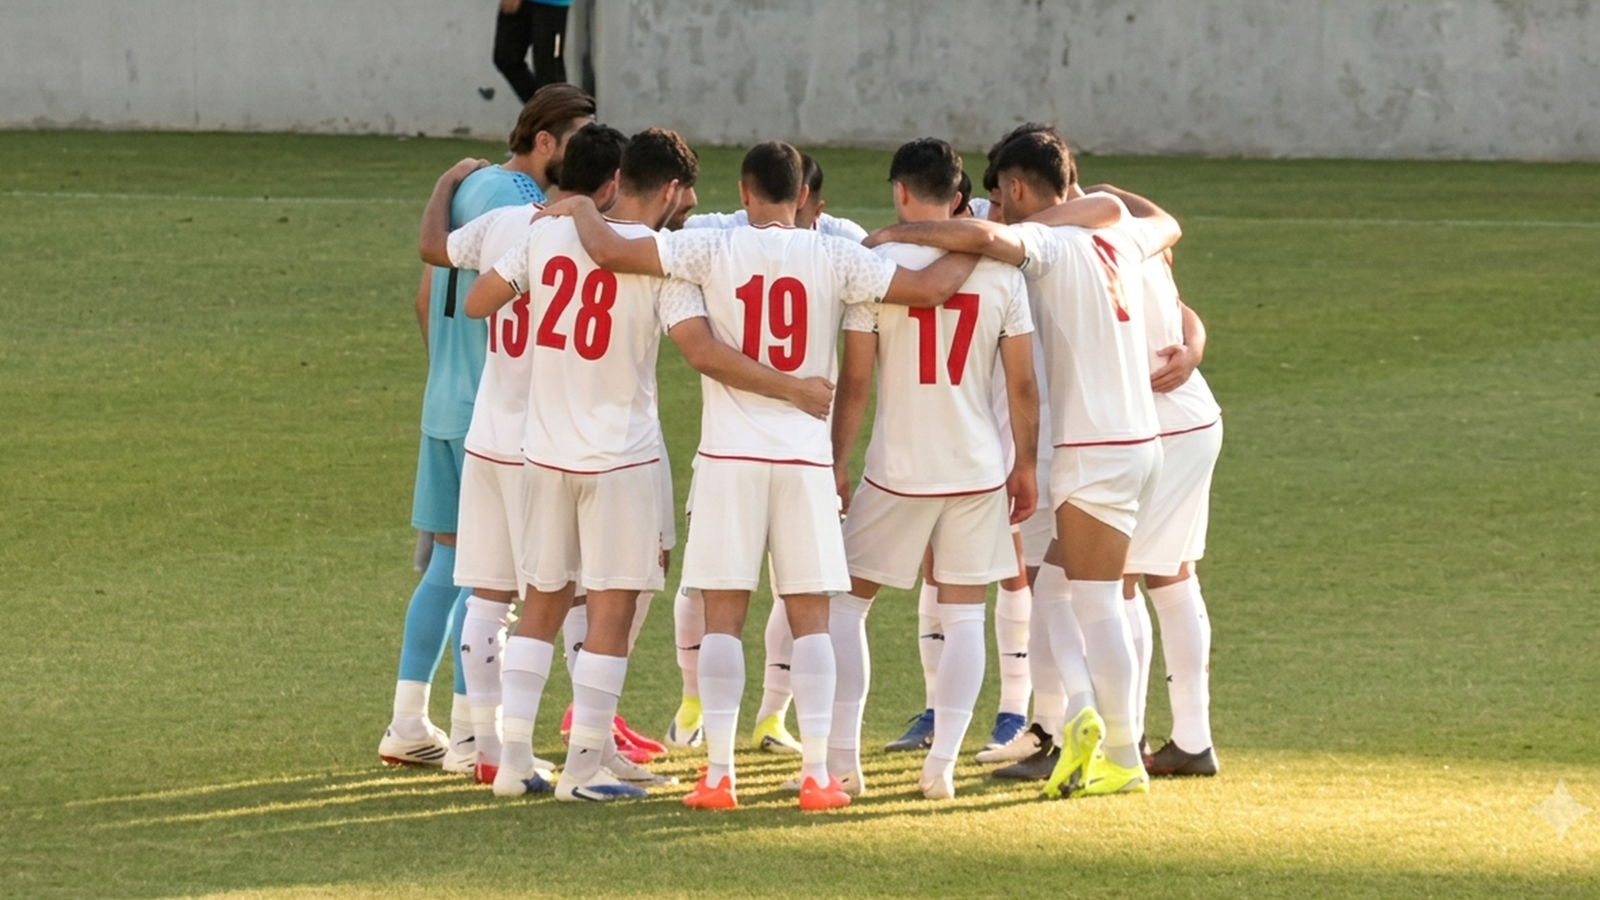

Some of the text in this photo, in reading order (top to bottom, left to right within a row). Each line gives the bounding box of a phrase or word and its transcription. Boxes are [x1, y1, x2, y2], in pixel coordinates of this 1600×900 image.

[536, 255, 618, 361] 28
[735, 274, 808, 372] 19
[908, 292, 980, 386] 17
